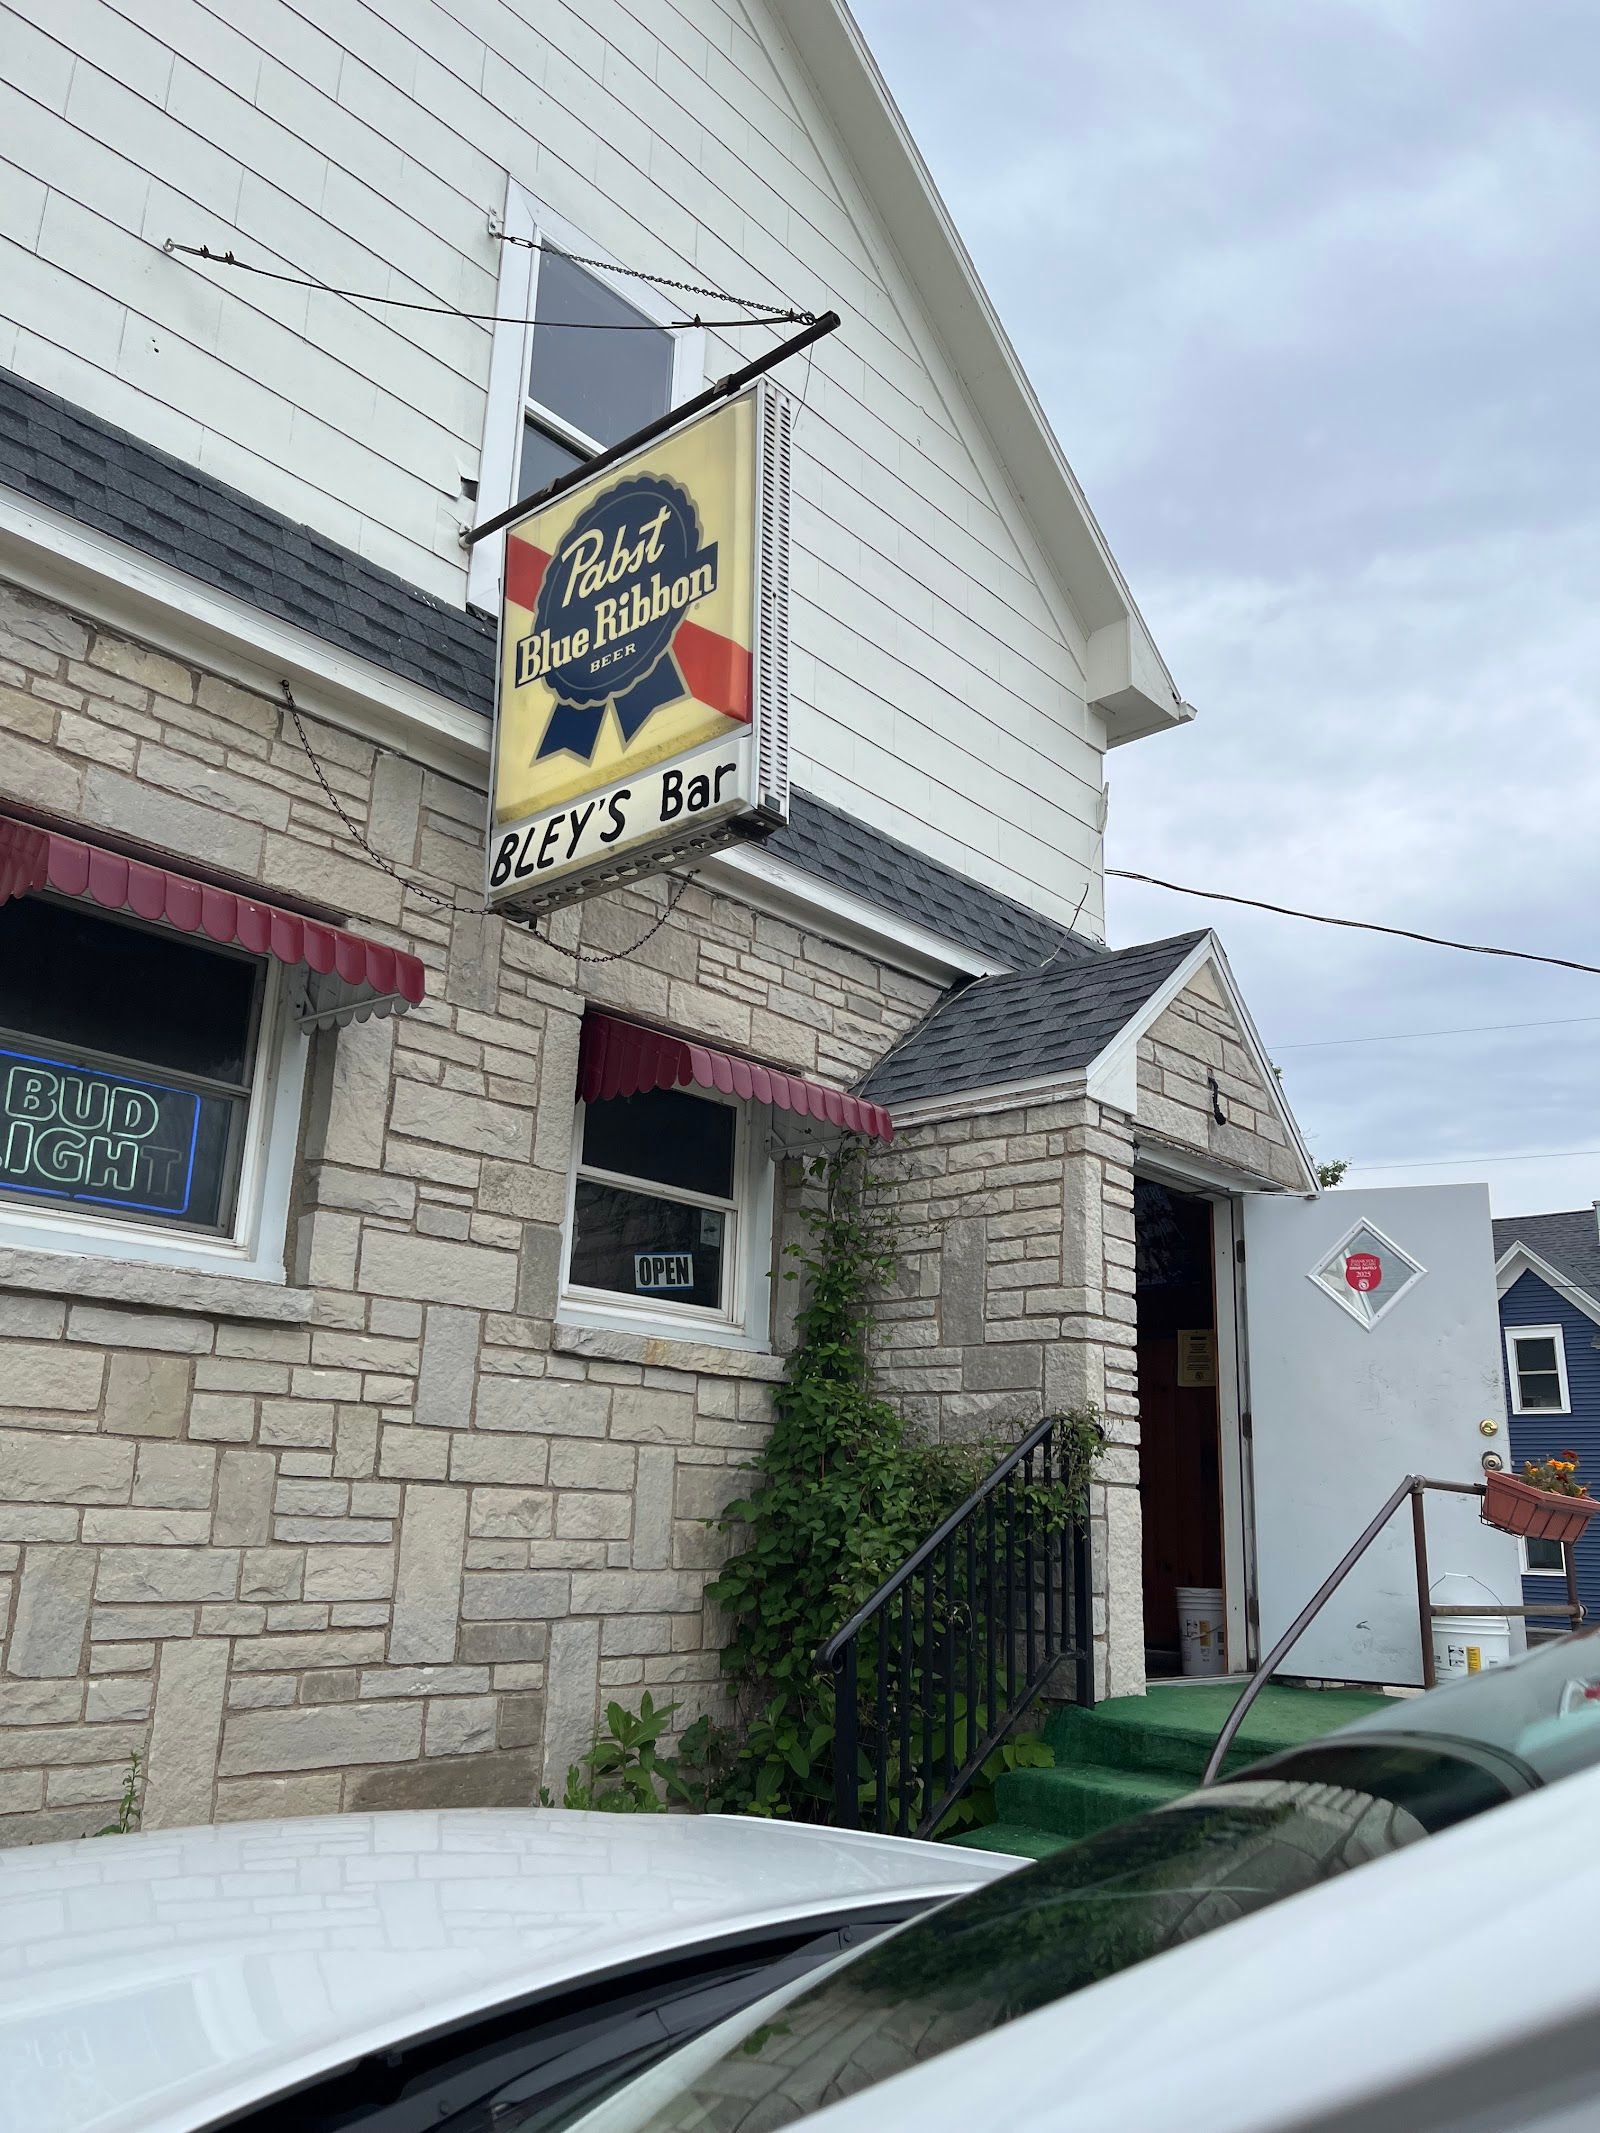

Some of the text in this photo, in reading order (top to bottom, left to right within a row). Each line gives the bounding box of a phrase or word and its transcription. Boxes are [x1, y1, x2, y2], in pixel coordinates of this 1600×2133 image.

[562, 505, 671, 608] Pabst
[518, 563, 715, 685] Blue Ribbon
[590, 643, 637, 673] BEER
[490, 763, 737, 887] BLEY'S Bar
[5, 1066, 160, 1139] BUD
[0, 1121, 183, 1195] IGHT
[639, 1256, 690, 1286] OPEN
